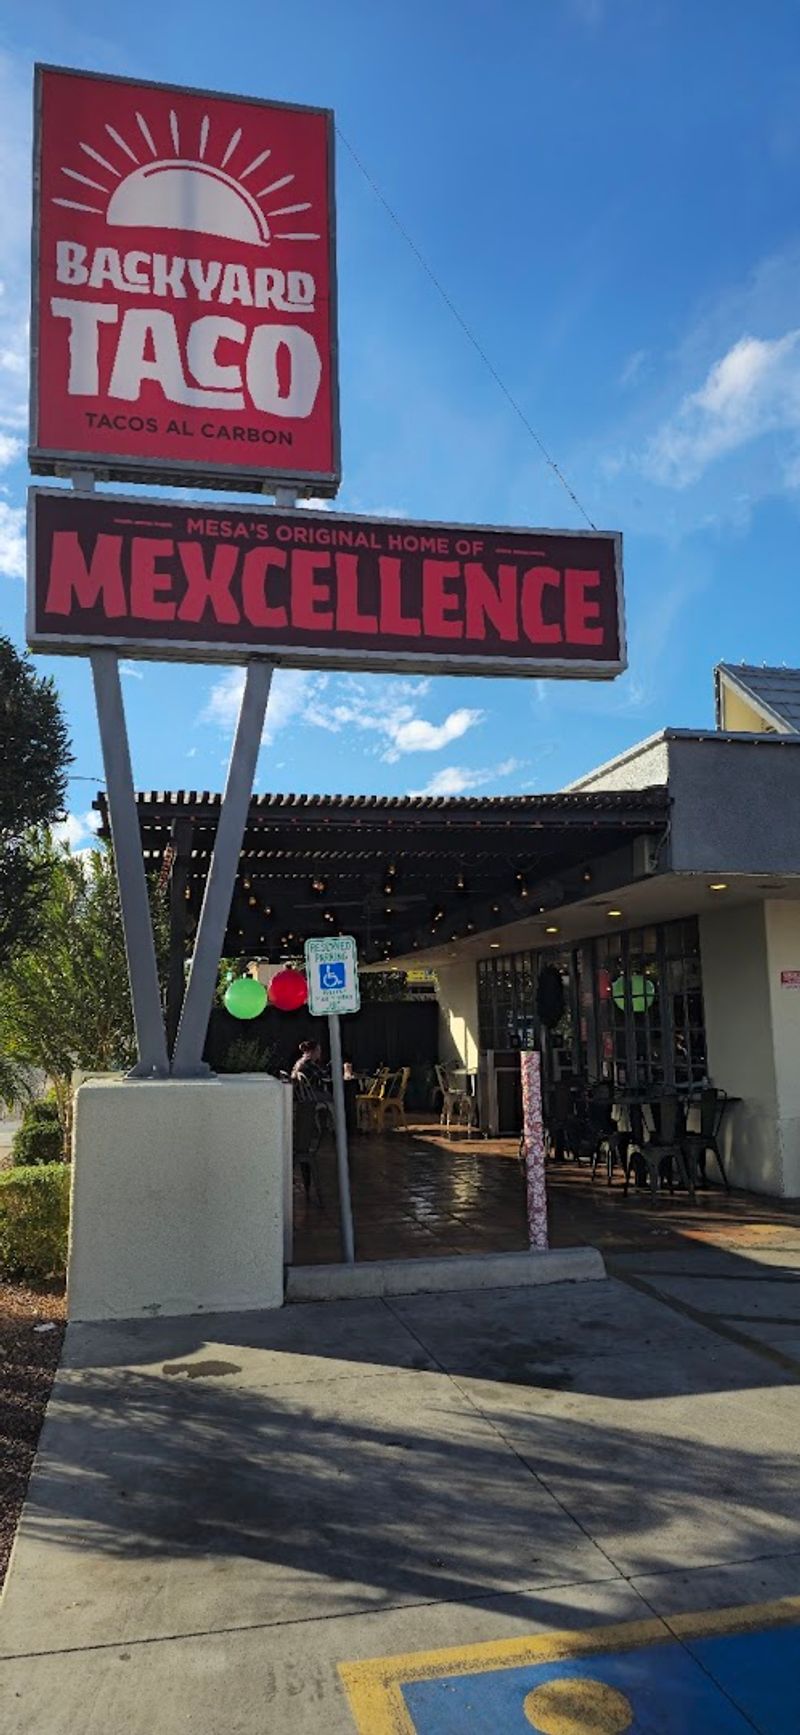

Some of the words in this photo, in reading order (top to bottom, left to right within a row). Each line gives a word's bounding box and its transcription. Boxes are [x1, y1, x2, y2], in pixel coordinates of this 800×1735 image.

[56, 241, 316, 312] BACKYARD
[51, 298, 322, 418] TACO
[86, 412, 158, 433] TACOS
[166, 416, 194, 436] AL
[201, 423, 292, 446] CARBON
[186, 517, 268, 540] MESA'S
[279, 526, 382, 548] ORIGINAL
[388, 535, 450, 555] HOME
[455, 540, 484, 556] OF
[44, 531, 603, 645] MEXCELLENCE
